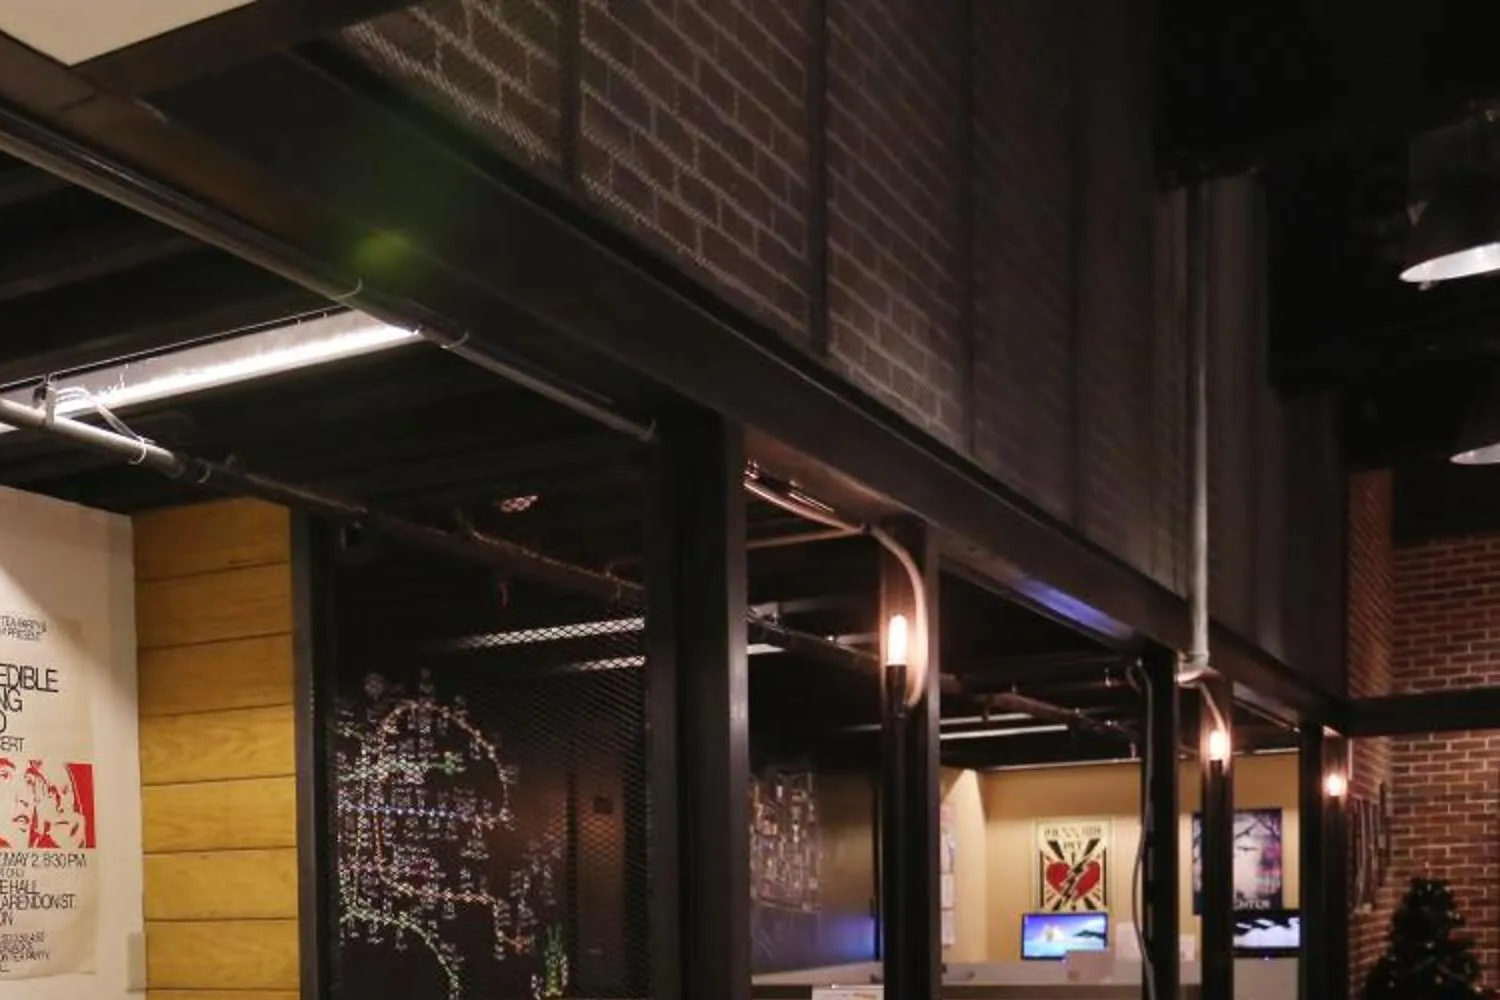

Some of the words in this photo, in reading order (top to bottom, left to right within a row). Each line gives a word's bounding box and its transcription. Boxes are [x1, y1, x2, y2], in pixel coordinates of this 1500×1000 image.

[3, 851, 29, 868] MAY
[68, 853, 88, 869] PM
[10, 879, 40, 895] HALL
